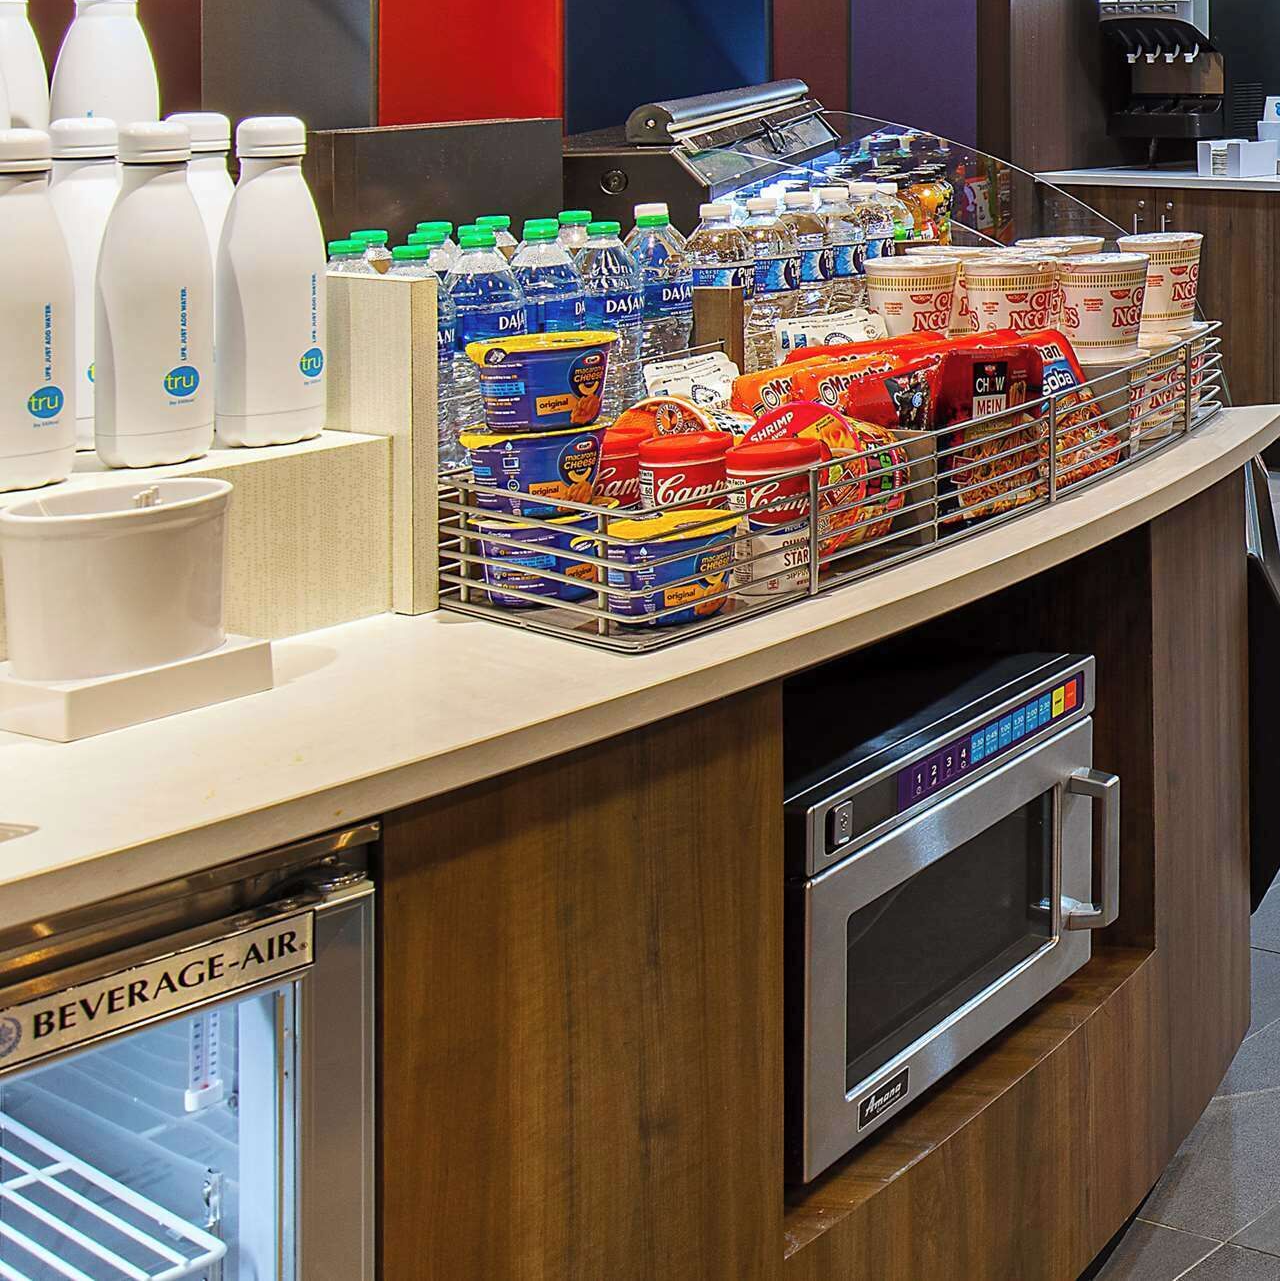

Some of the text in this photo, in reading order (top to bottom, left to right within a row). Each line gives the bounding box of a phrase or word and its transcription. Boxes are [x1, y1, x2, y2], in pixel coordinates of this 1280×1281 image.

[300, 355, 321, 371] tru
[165, 374, 194, 390] tru
[29, 395, 59, 411] tru
[539, 398, 569, 410] original
[977, 398, 1003, 416] MEIN
[751, 411, 794, 442] SHRIMP
[531, 485, 560, 496] original
[736, 495, 745, 504] 60
[666, 588, 696, 601] original
[1039, 700, 1051, 712] 2:30
[1027, 707, 1038, 719] 2:00
[960, 748, 966, 758] 4
[946, 756, 952, 767] 3
[931, 764, 937, 776] 2
[917, 773, 922, 784] 1
[33, 929, 298, 1039] BEVERAGE-AIR
[864, 1082, 902, 1117] Amana
